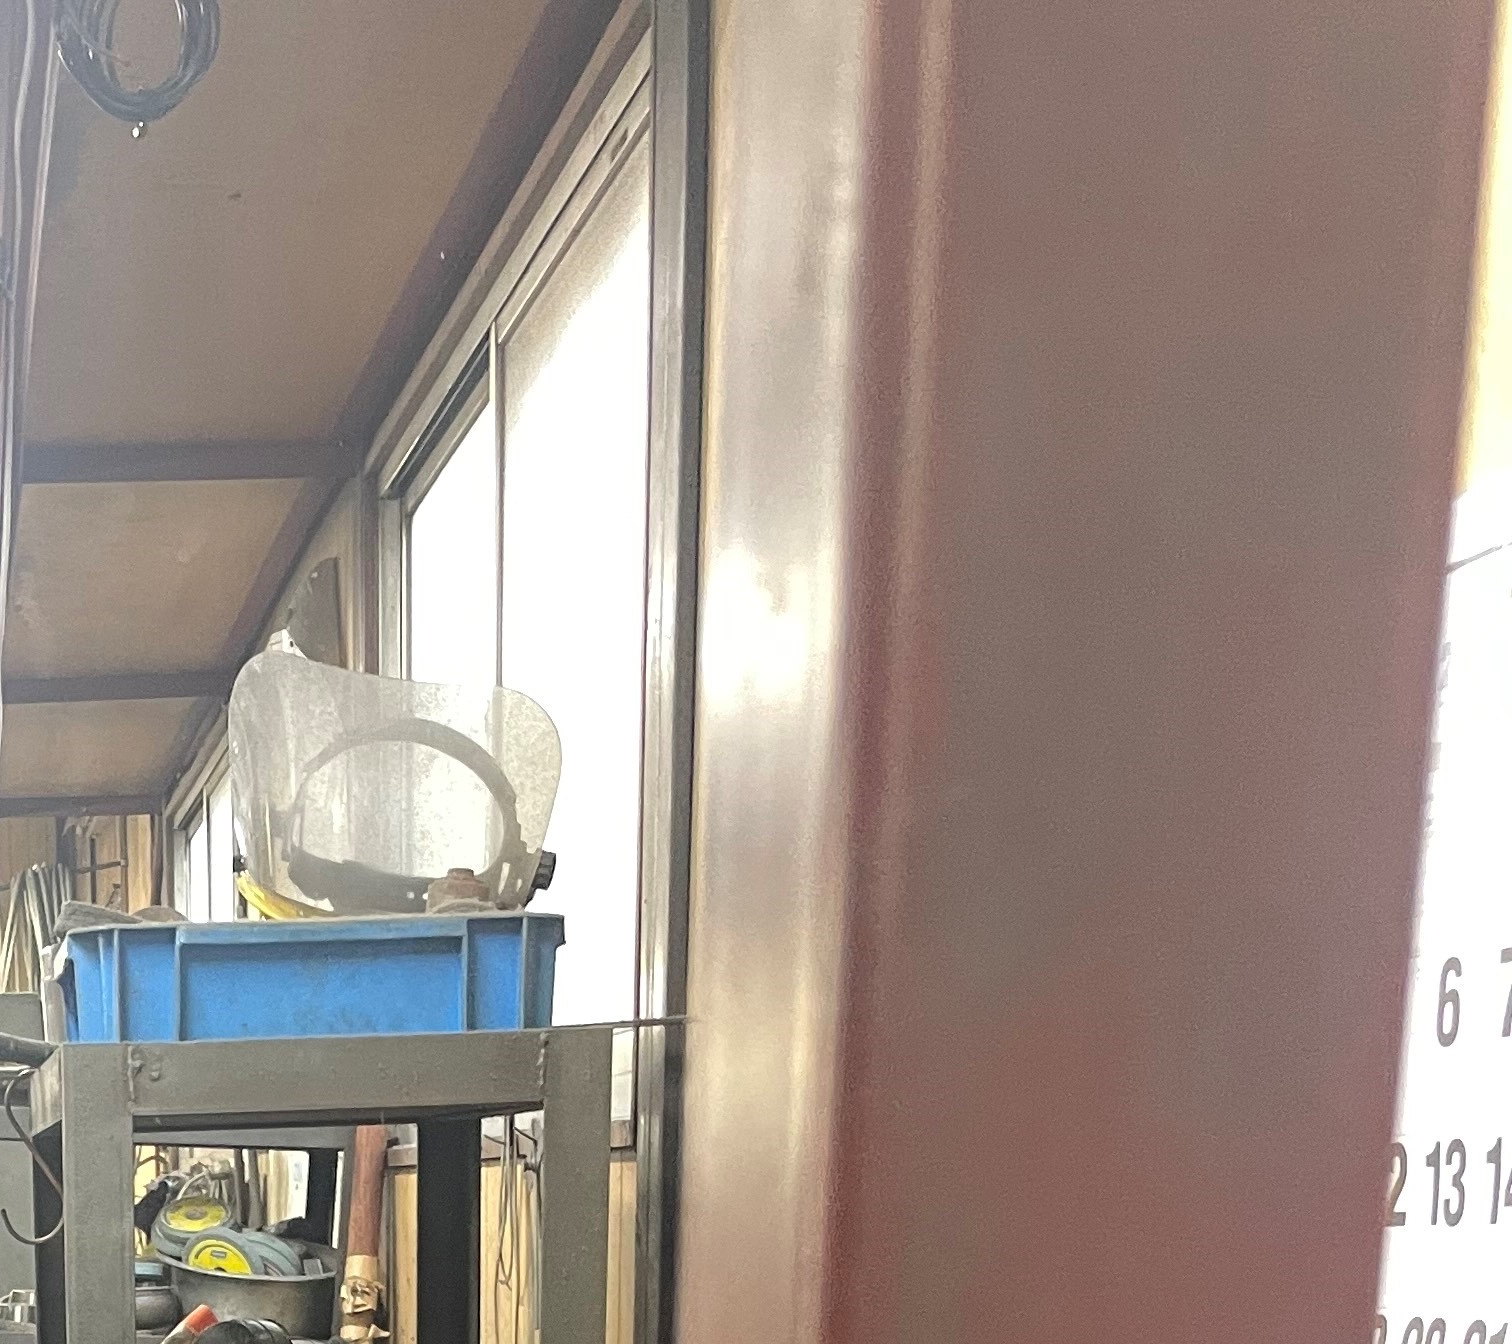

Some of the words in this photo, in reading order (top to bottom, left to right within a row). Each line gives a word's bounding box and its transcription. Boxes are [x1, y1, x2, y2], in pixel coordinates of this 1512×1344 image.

[1437, 957, 1462, 1047] 6
[1387, 1142, 1408, 1227] 2
[1426, 1138, 1466, 1227] 13
